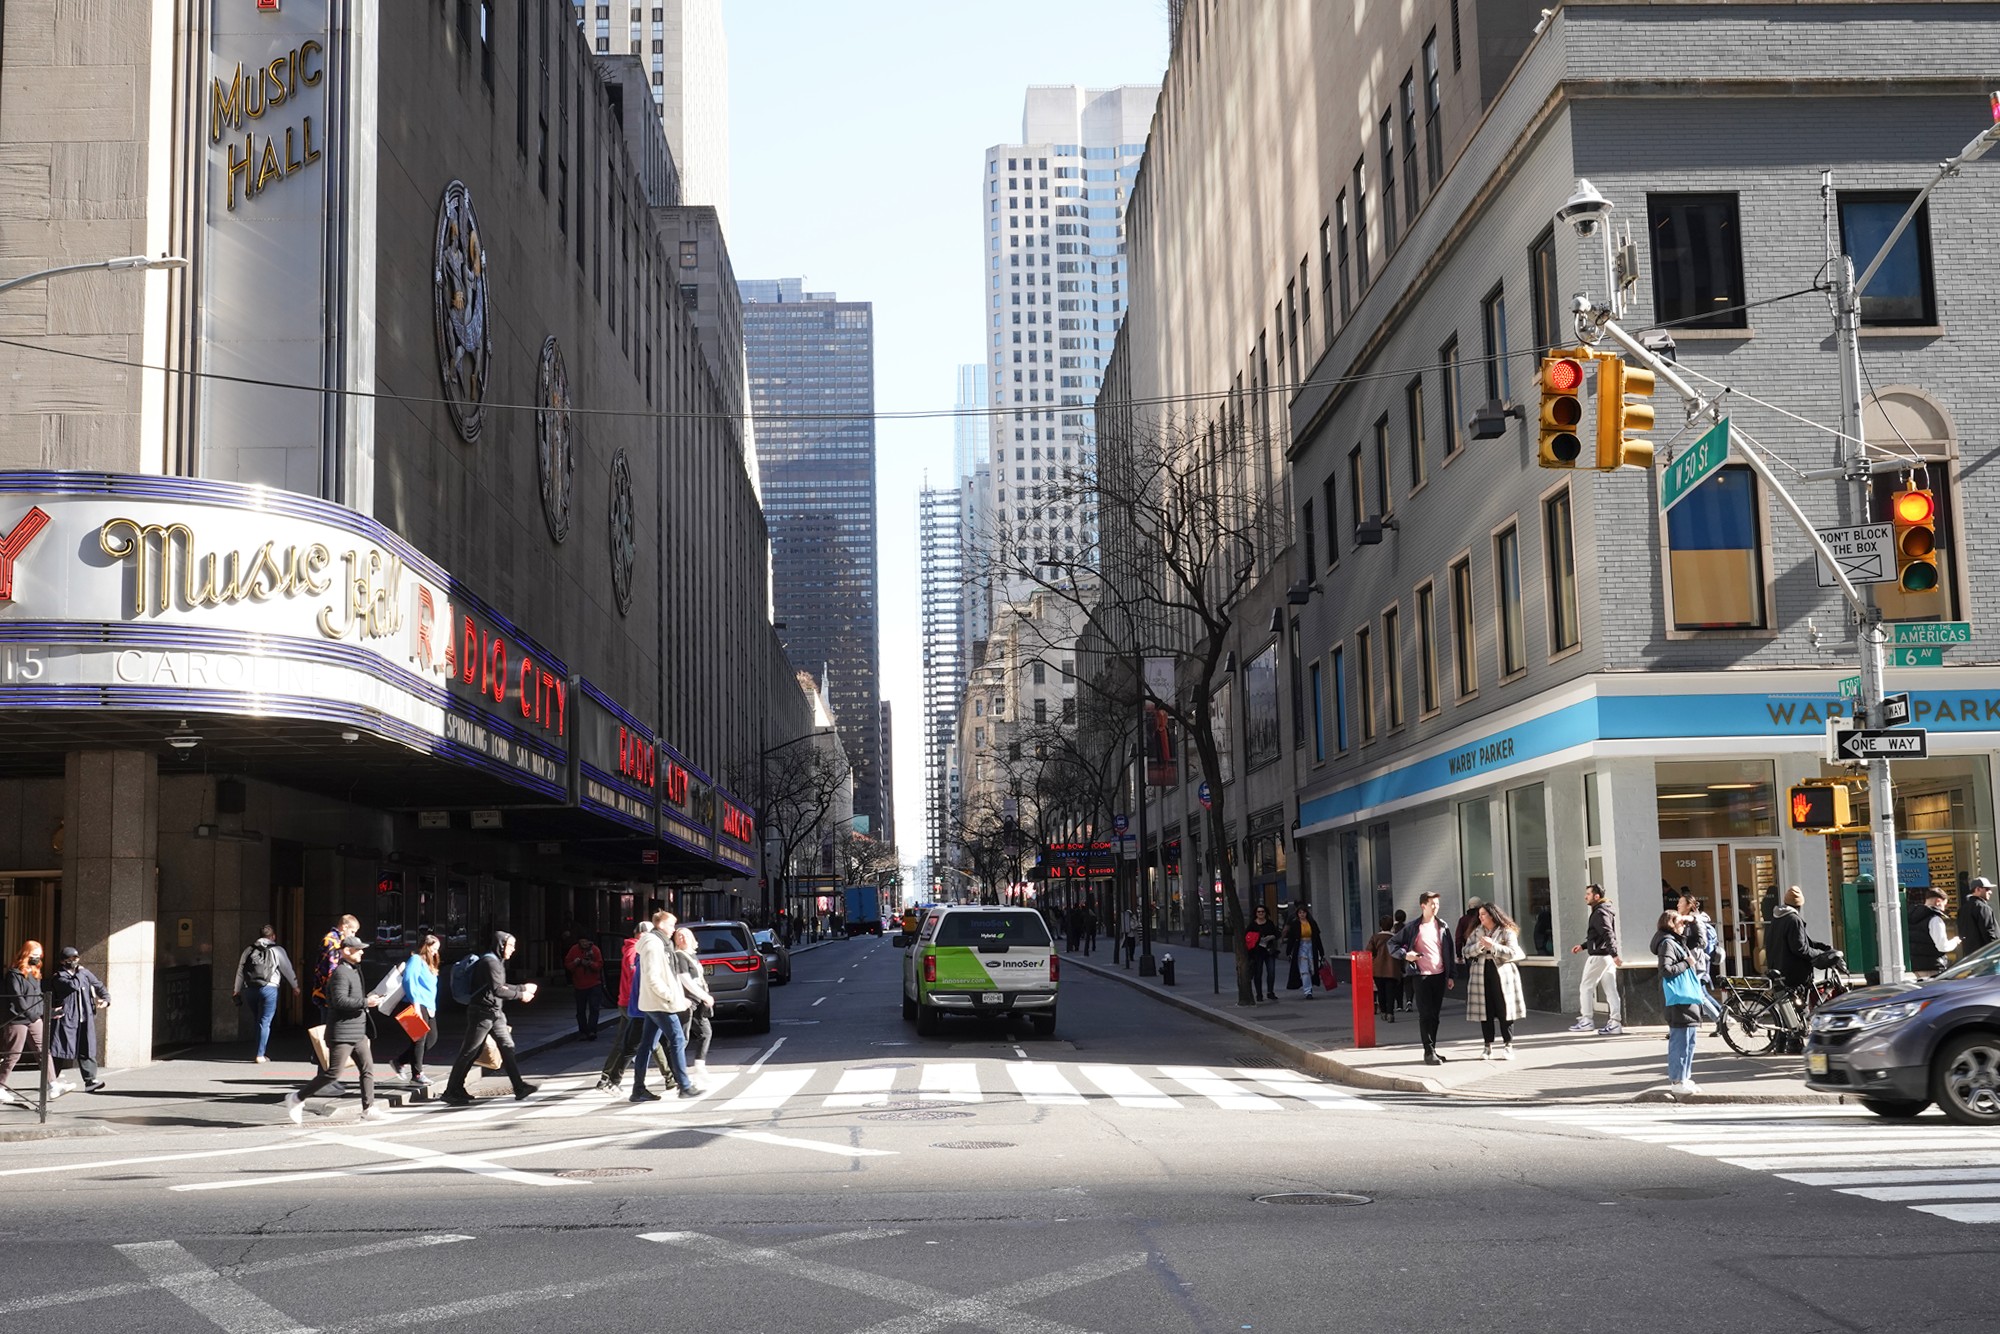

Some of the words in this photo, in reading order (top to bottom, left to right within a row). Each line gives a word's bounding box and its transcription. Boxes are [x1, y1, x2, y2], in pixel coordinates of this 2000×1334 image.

[213, 40, 323, 144] MUSIC
[227, 116, 321, 211] HALL
[1675, 463, 1683, 491] W
[1685, 451, 1697, 484] 50
[1699, 442, 1709, 471] St
[1820, 533, 1850, 544] DON'T
[1854, 528, 1889, 541] BLOCK
[1833, 544, 1853, 554] THE
[1857, 542, 1878, 553] BOX
[1900, 630, 1967, 642] AMERICAS
[416, 583, 508, 703] RADIO
[521, 656, 567, 736] CITY
[1905, 649, 1917, 666] 6
[1921, 648, 1933, 658] AV
[1888, 703, 1904, 718] WAY
[447, 713, 488, 752] SPIRALING
[491, 733, 510, 762] TOUR
[532, 752, 545, 777] MAY
[547, 760, 556, 781] 20
[1851, 738, 1877, 751] ONE
[1888, 738, 1915, 750] WAY
[1448, 749, 1477, 776] WARBY
[1479, 737, 1515, 766] PARKER
[620, 726, 655, 788] RADIO
[668, 760, 688, 808] CITY
[1903, 847, 1926, 860] $95
[1676, 859, 1698, 868] 1258
[981, 932, 997, 941] Hybrid
[942, 977, 986, 985] innoserv.com
